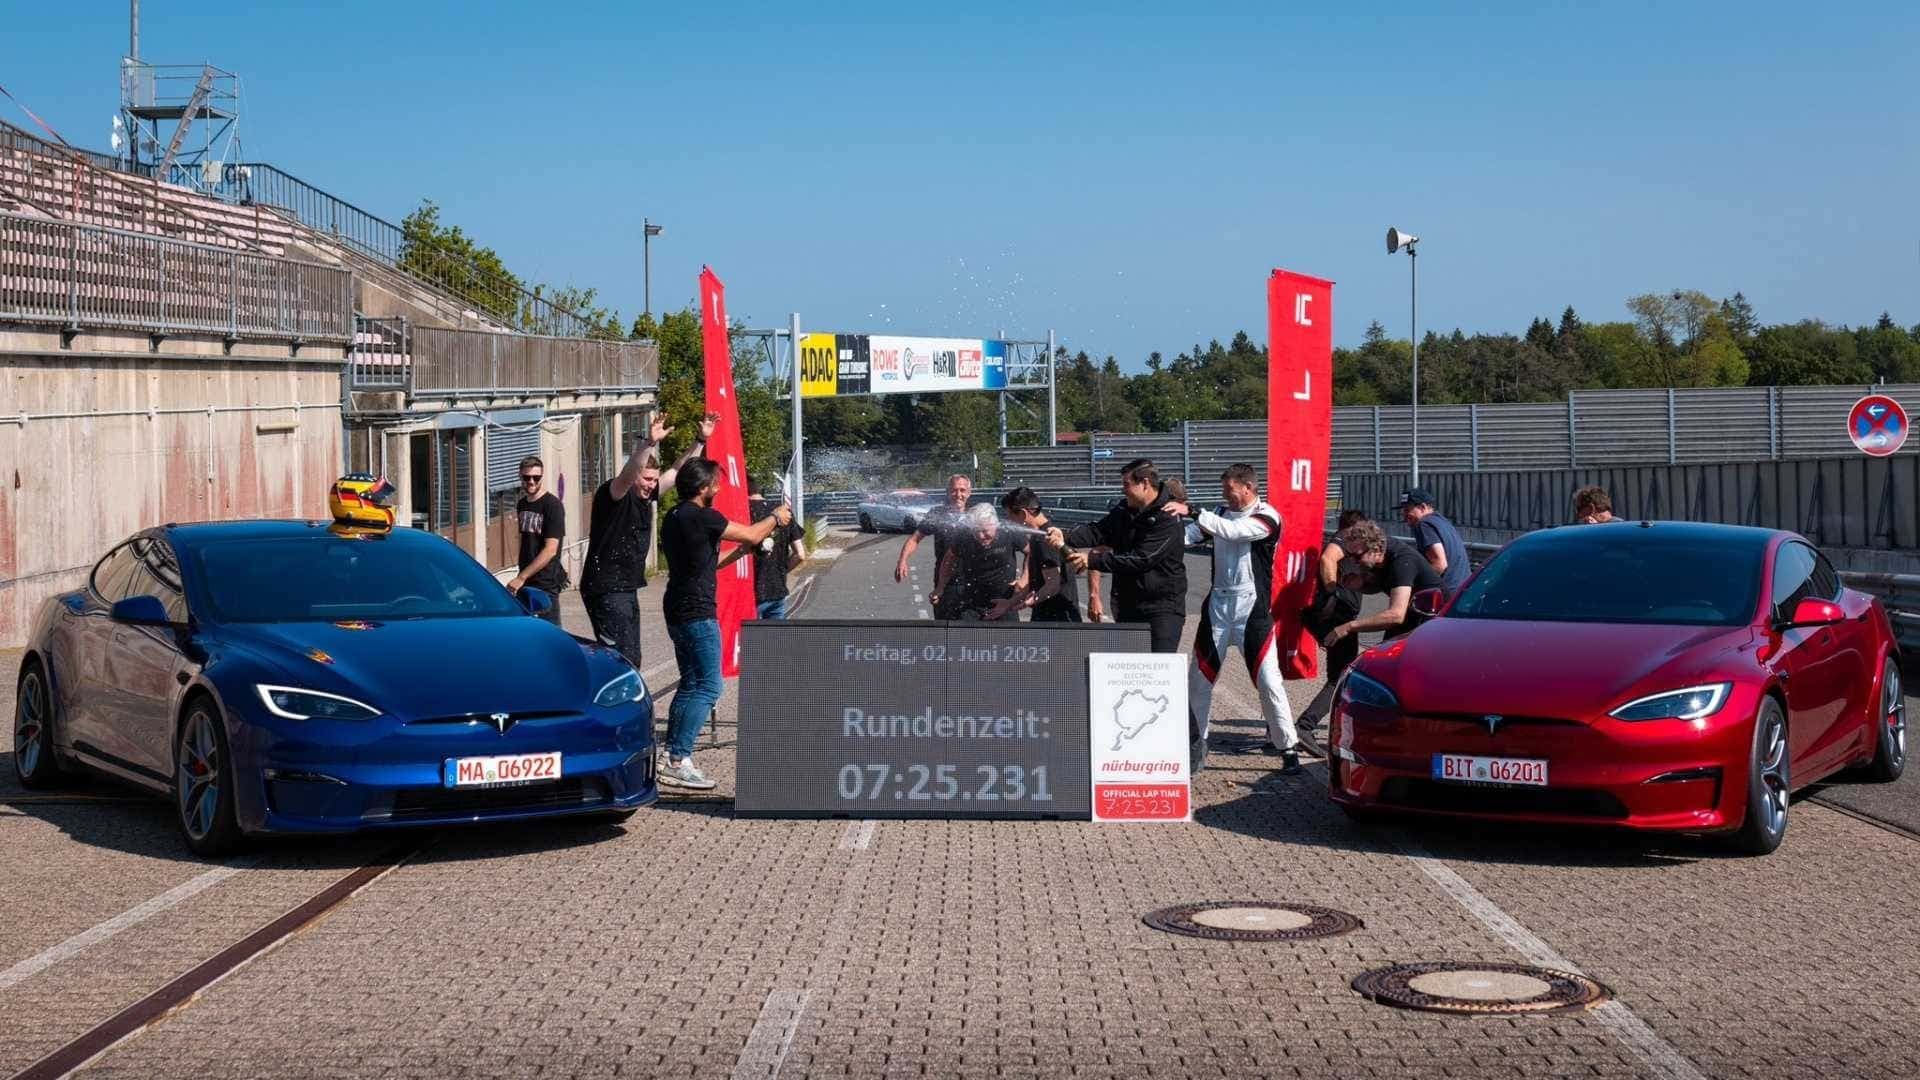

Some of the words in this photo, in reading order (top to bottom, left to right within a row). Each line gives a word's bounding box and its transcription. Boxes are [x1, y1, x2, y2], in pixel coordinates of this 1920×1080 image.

[800, 347, 834, 382] ADAC
[873, 349, 898, 371] ROWE
[1285, 293, 1313, 656] ESLA
[844, 644, 917, 664] Freitag,
[924, 645, 953, 662] 02.
[958, 645, 998, 662] Juni
[1003, 646, 1050, 662] 2023
[843, 706, 1051, 738] Rundenzeit:
[459, 762, 484, 782] MA
[498, 757, 554, 779] 06922
[1102, 760, 1180, 775] nürburgring
[1445, 758, 1473, 778] BIT
[1490, 761, 1544, 782] 06201
[838, 764, 1053, 800] 07:25.231
[1103, 789, 1140, 798] OFFICIAL
[1143, 789, 1158, 798] LAP
[1160, 789, 1180, 798] TIME
